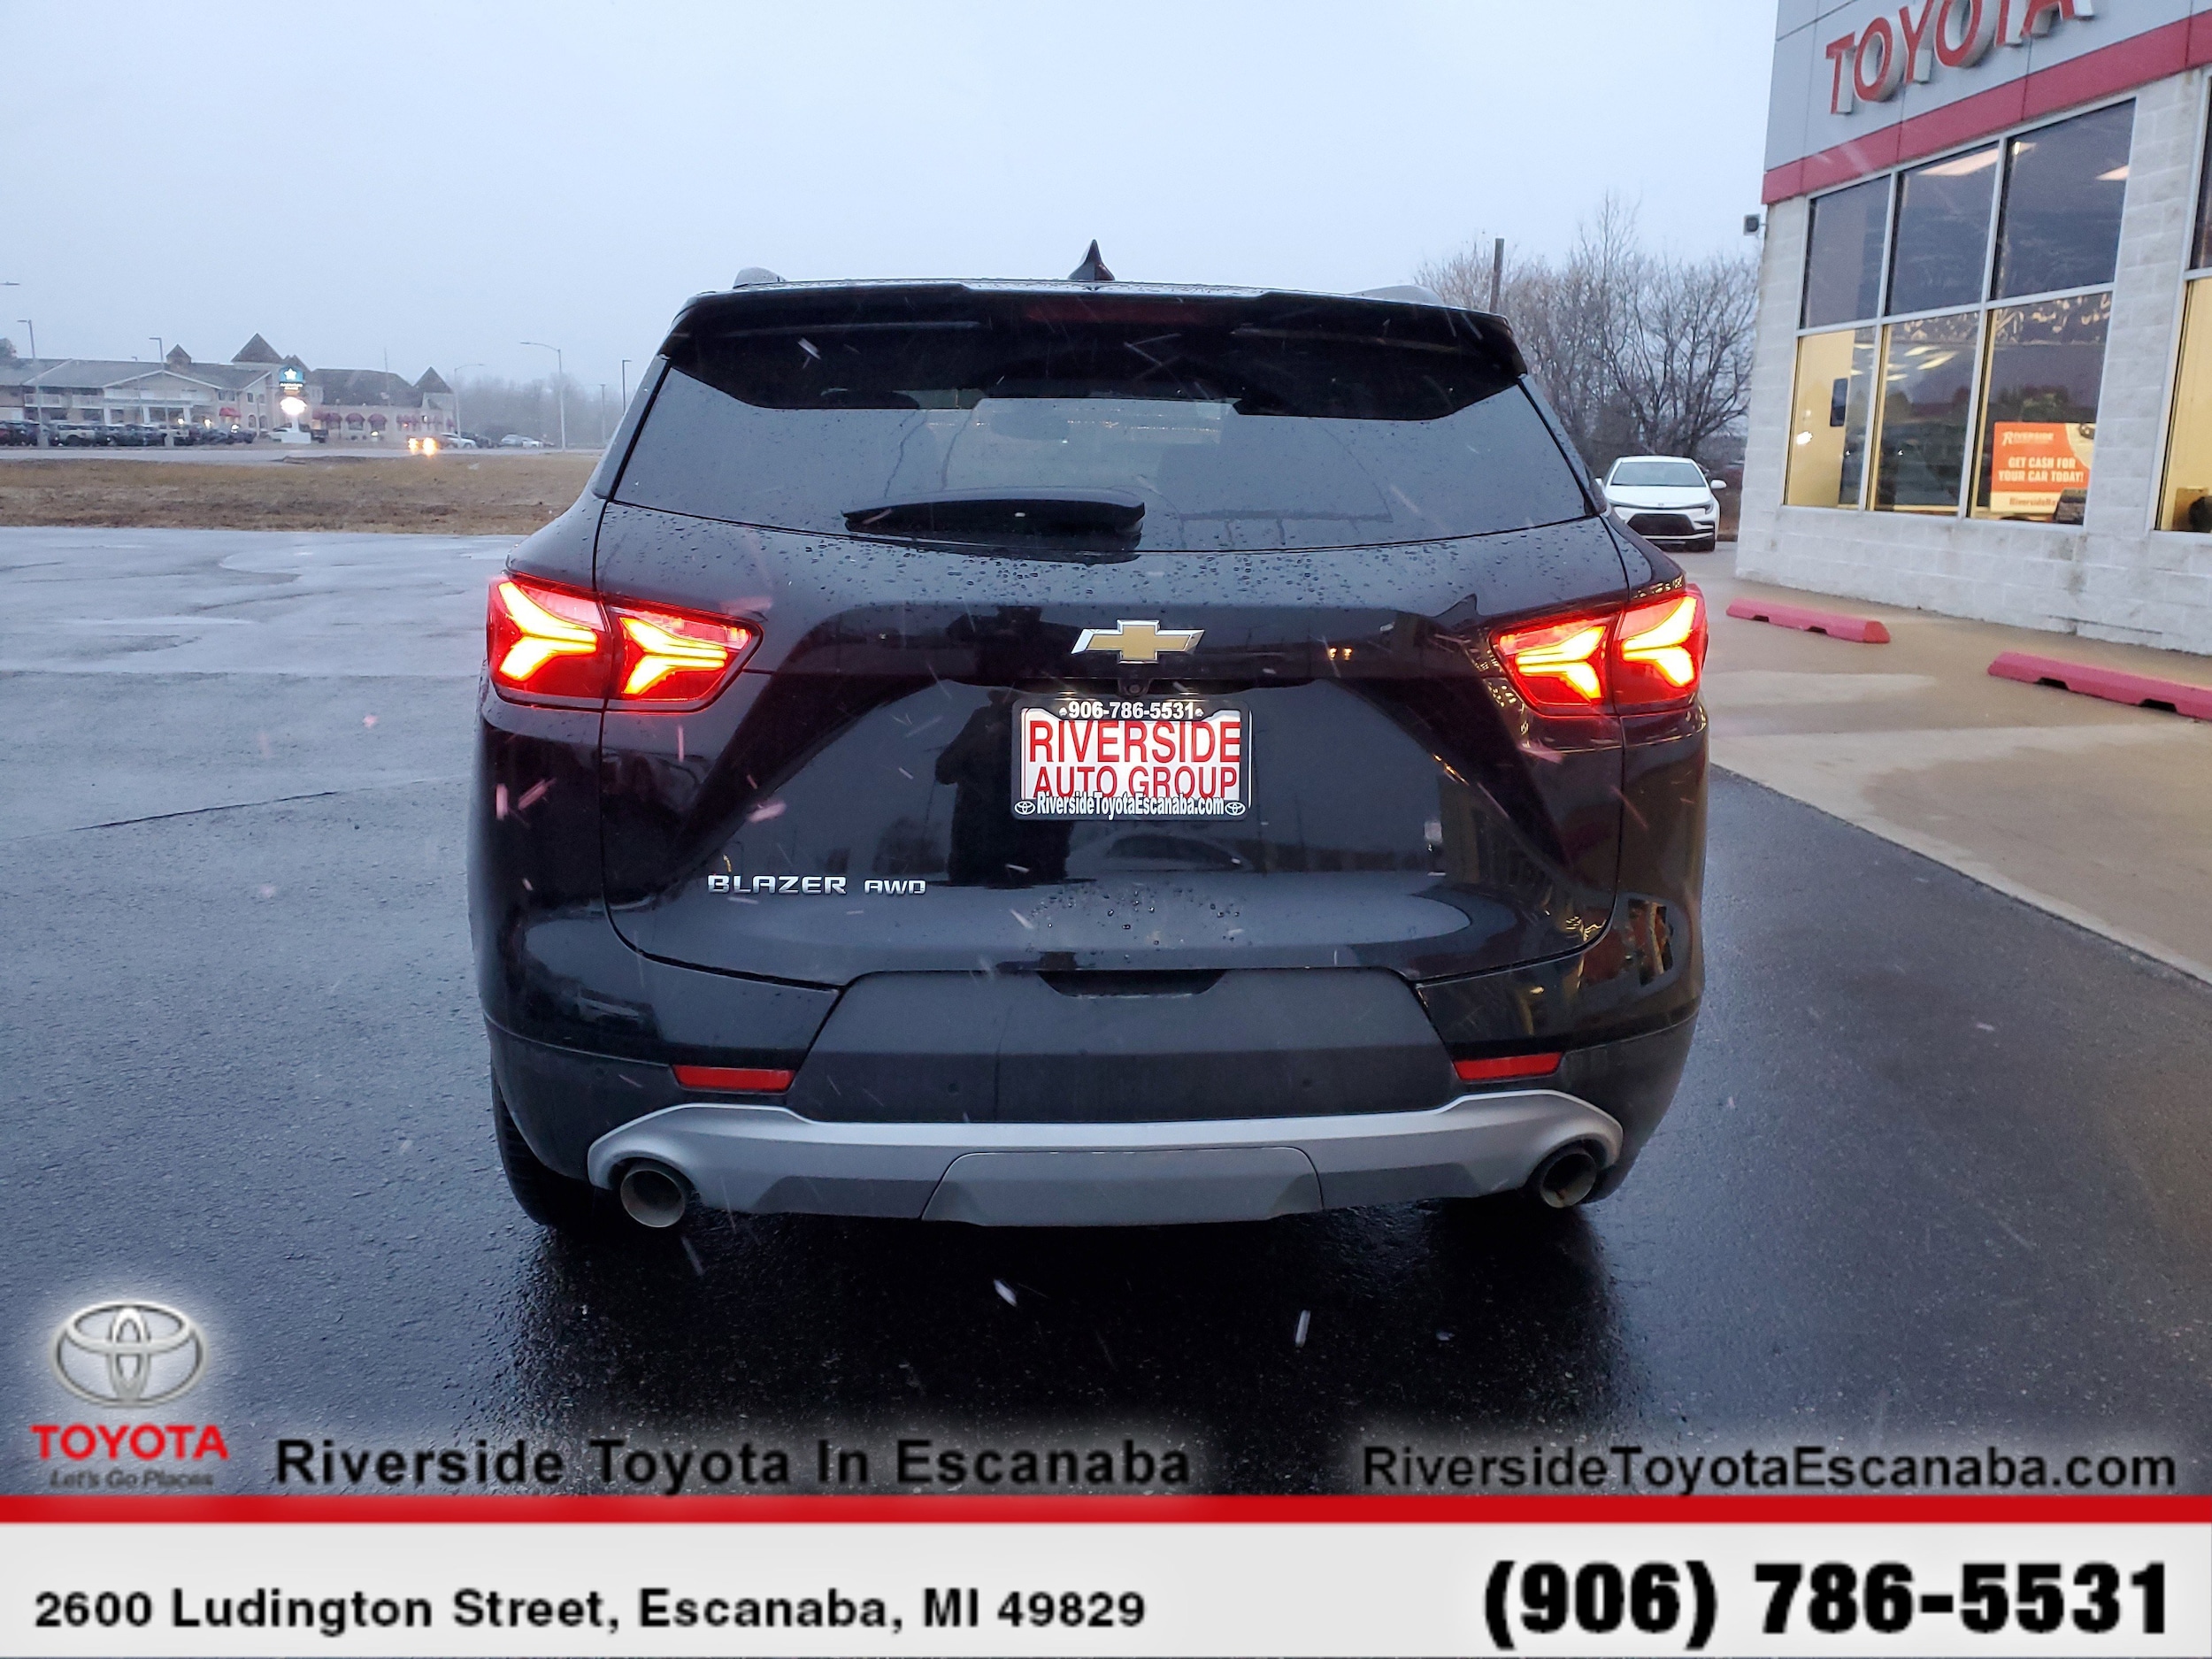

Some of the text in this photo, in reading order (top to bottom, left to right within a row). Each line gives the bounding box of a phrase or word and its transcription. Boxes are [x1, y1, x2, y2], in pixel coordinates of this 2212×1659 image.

[2008, 457, 2026, 469] GET
[2056, 457, 2076, 469] FOR
[1999, 470, 2084, 483] YOUR CAR TODAY!
[1069, 701, 1194, 719] 906-786-5531
[1030, 720, 1240, 763] RIVERSIDE
[1033, 766, 1237, 800] AUTO GROUP
[1036, 791, 1225, 820] RiversideToyotaEscanaba.com
[707, 875, 926, 895] BLAZER AWD
